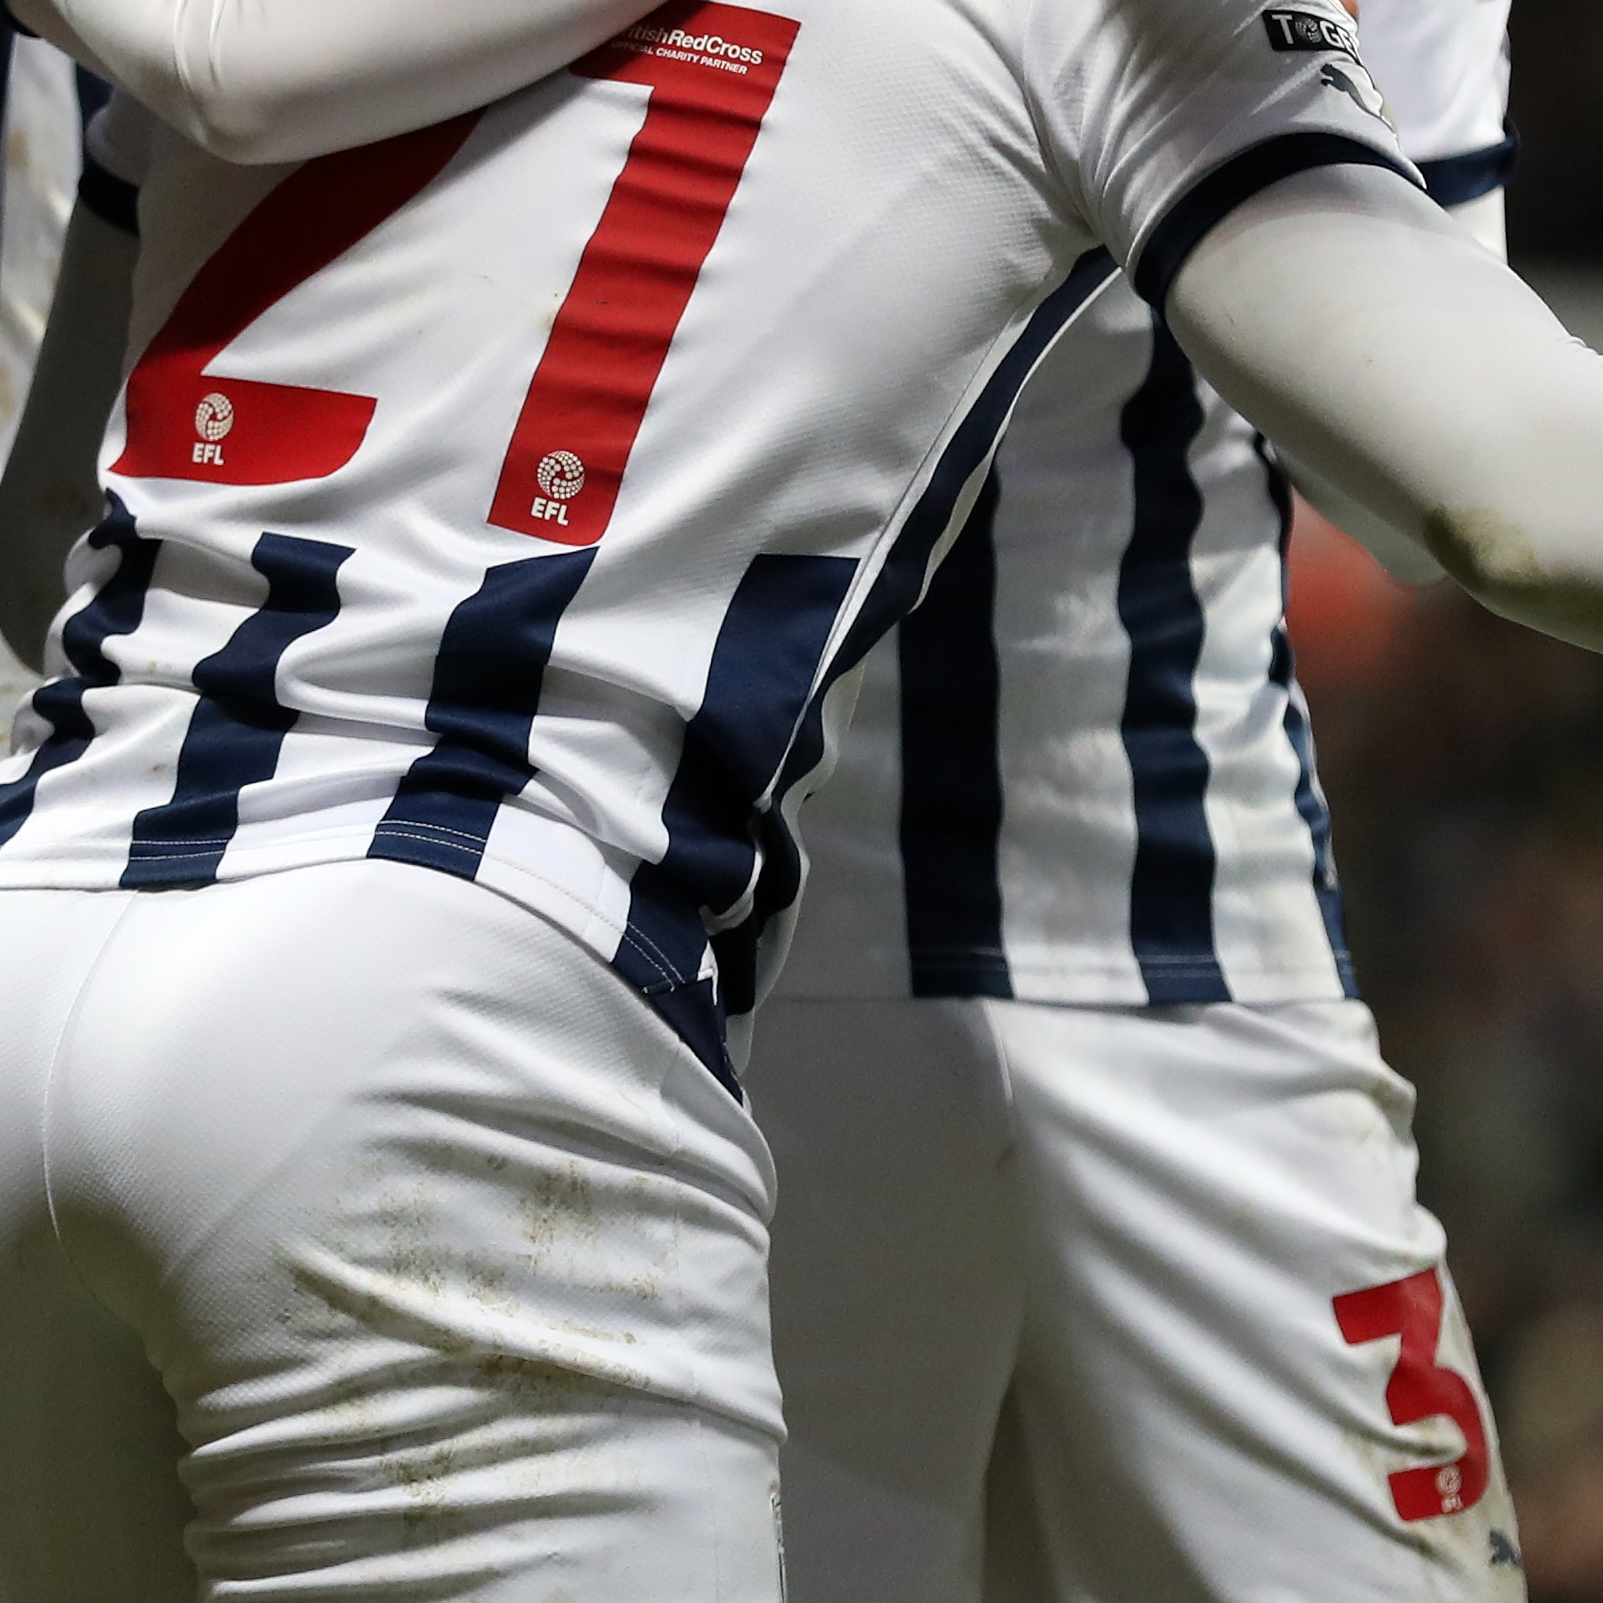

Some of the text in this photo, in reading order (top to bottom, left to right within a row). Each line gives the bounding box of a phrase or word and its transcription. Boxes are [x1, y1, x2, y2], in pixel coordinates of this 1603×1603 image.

[655, 46, 700, 65] CHARITY
[699, 54, 749, 76] PARTNER
[193, 441, 224, 466] EFL
[530, 496, 570, 526] EFL
[1331, 1266, 1491, 1523] 3
